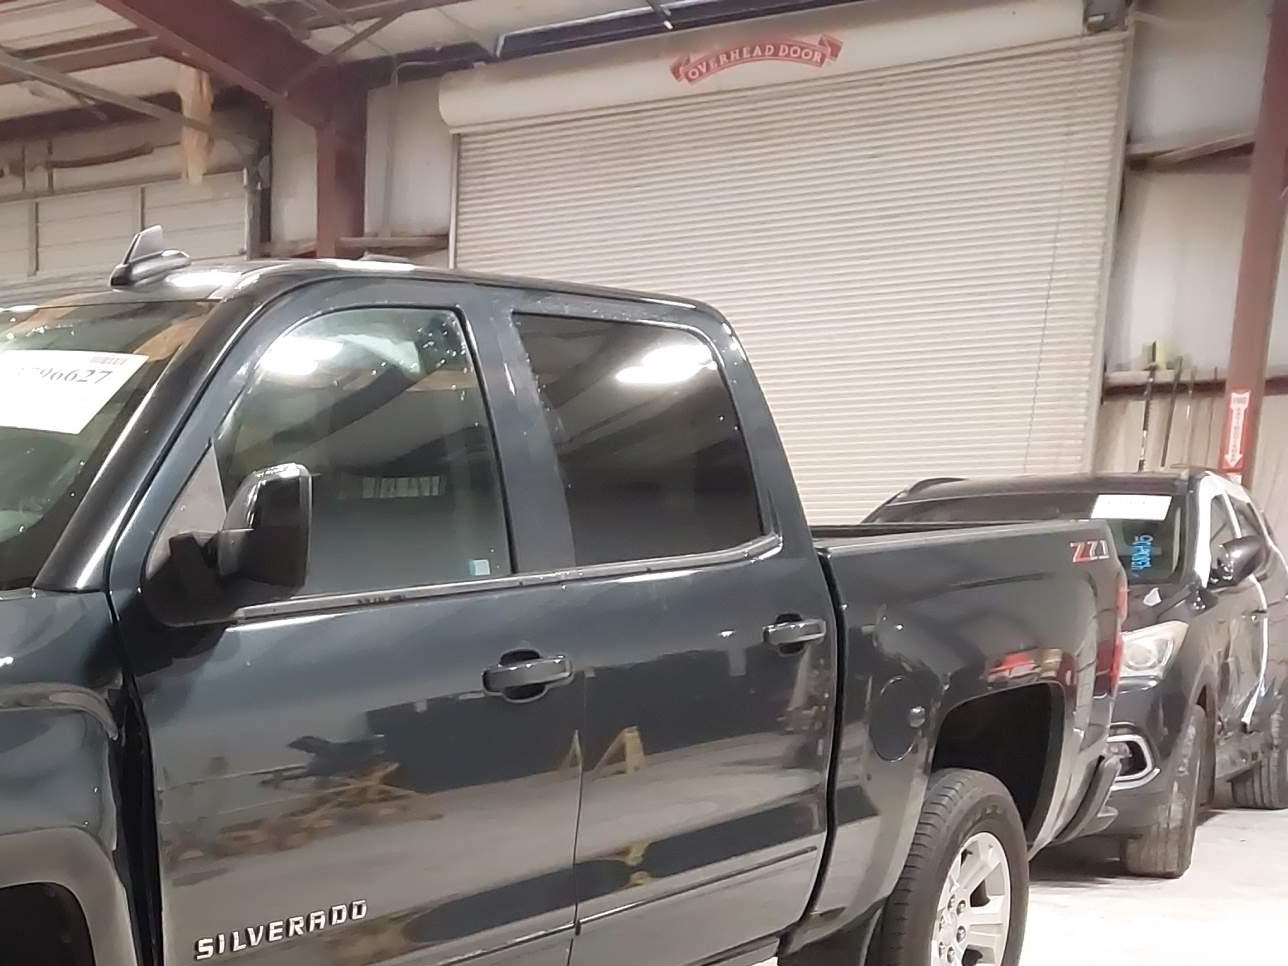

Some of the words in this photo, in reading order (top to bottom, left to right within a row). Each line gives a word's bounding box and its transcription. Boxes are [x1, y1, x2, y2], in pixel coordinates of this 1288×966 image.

[687, 44, 775, 80] OVERHEAD
[777, 45, 822, 63] DOOR
[1070, 539, 1110, 563] Z71
[195, 899, 368, 961] SILVERADO
